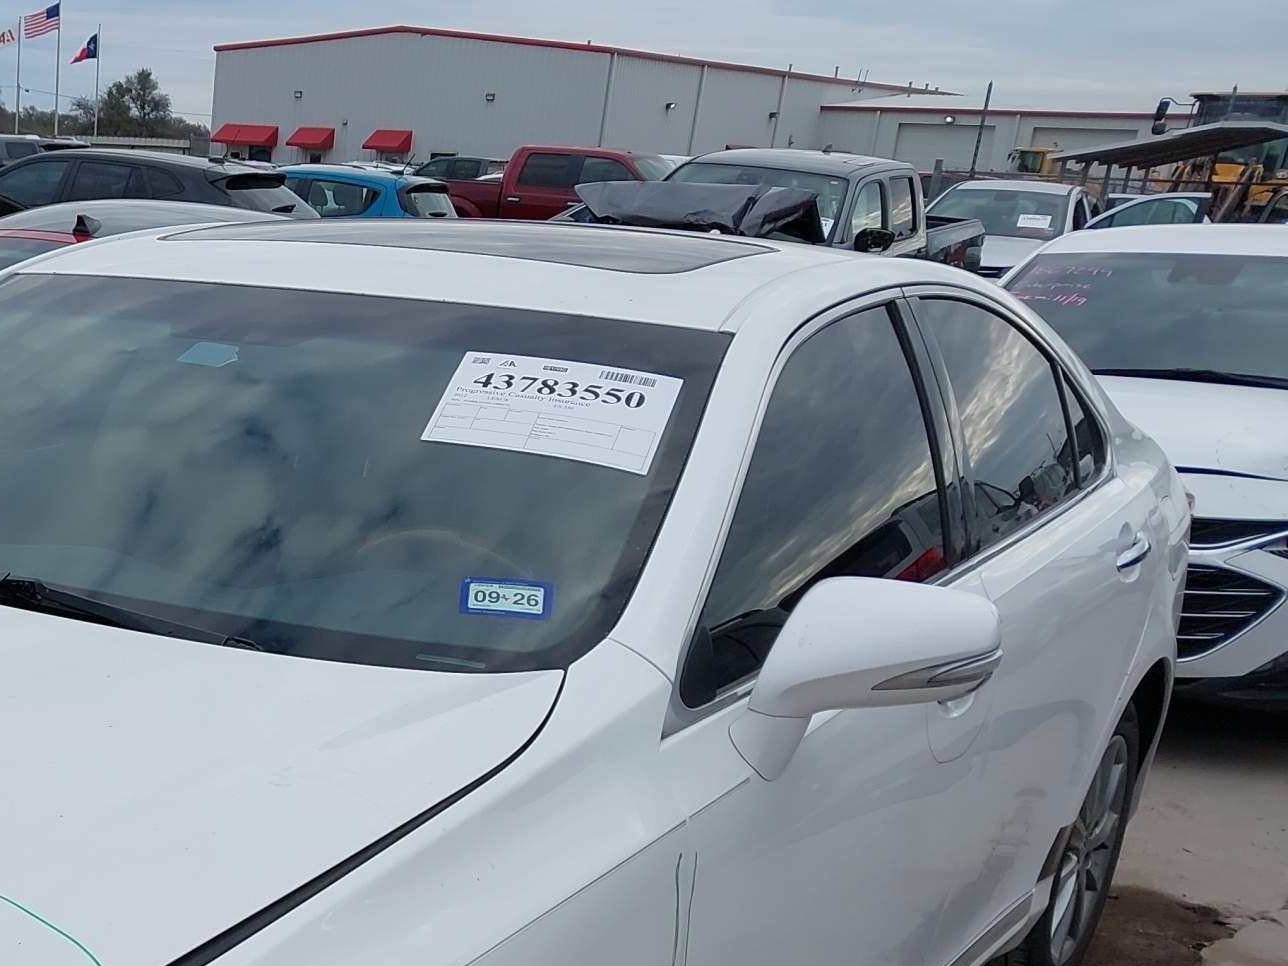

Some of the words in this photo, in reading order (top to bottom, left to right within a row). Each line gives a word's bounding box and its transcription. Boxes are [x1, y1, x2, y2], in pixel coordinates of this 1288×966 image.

[456, 386, 507, 397] Progressive
[508, 391, 546, 401] Casualty
[549, 396, 591, 408] Insurance
[472, 372, 646, 409] 43783550
[474, 590, 500, 603] 09
[512, 592, 539, 607] 26
